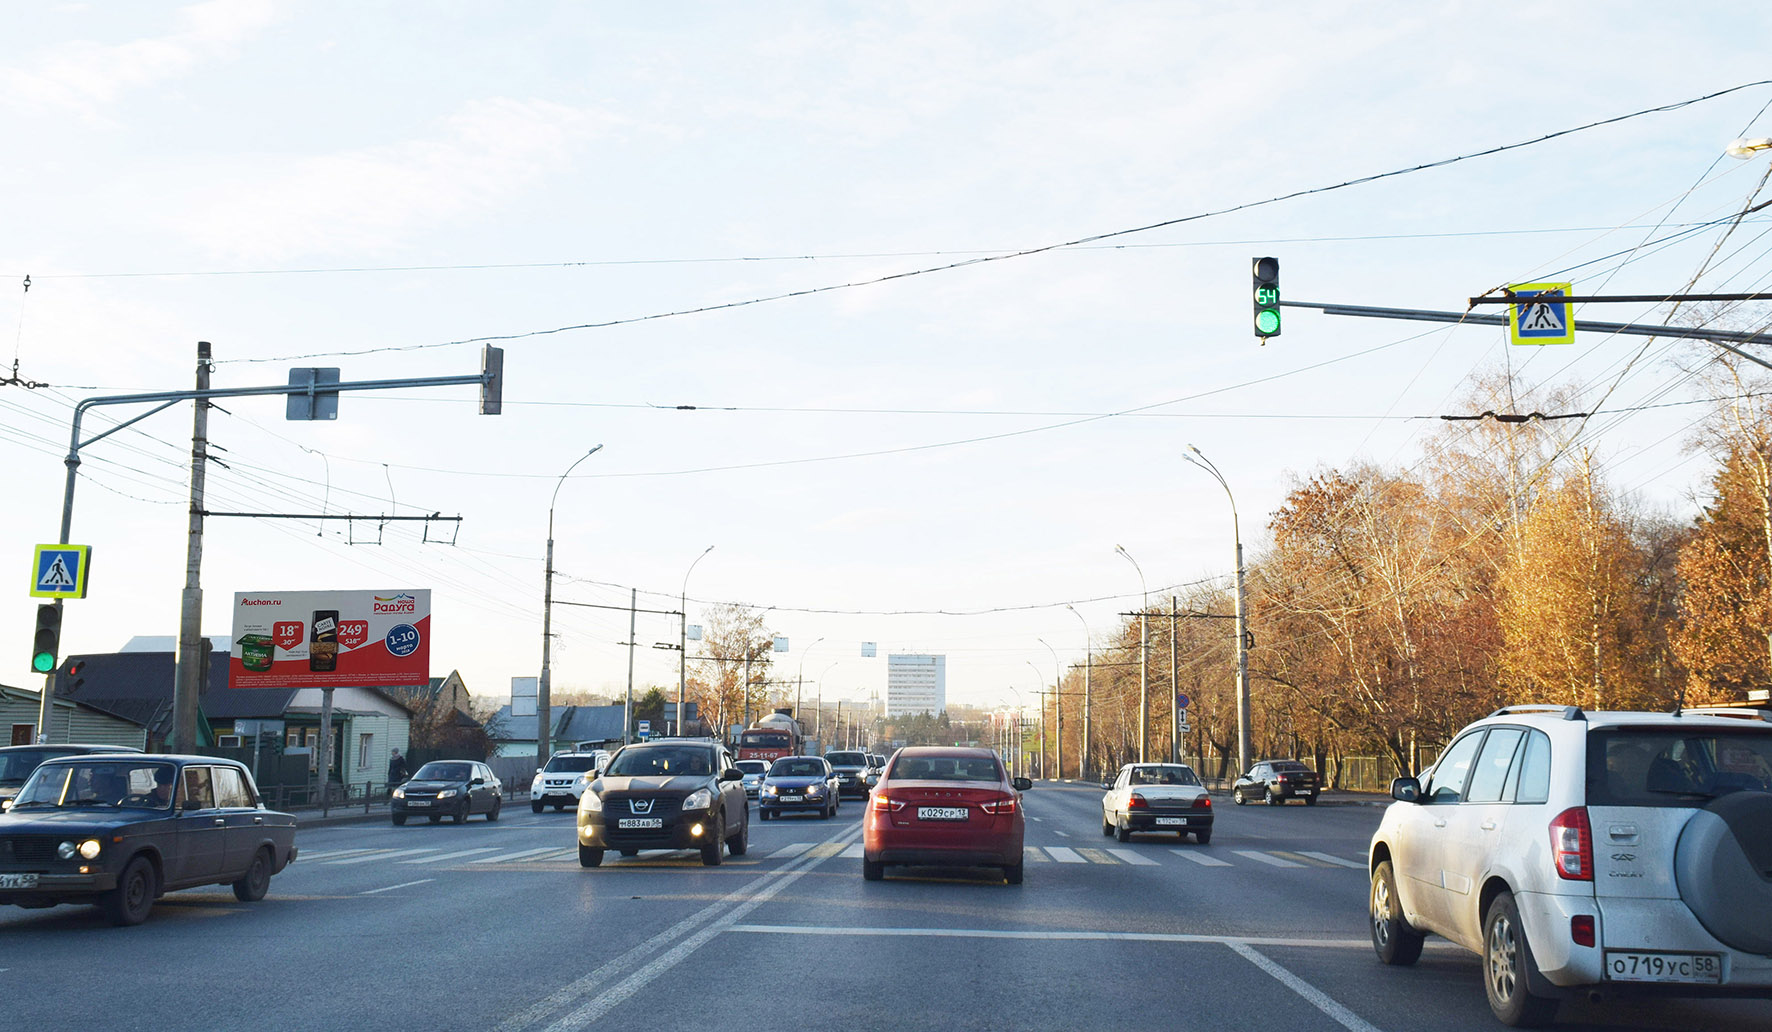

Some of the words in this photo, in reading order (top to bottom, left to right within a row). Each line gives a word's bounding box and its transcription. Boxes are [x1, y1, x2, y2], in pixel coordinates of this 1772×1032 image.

[241, 598, 282, 606] Auchan.ru
[373, 602, 415, 612] Радуга
[280, 625, 294, 637] 18
[339, 625, 362, 635] 249
[389, 631, 415, 646] 1-10
[1695, 958, 1713, 972] 58
